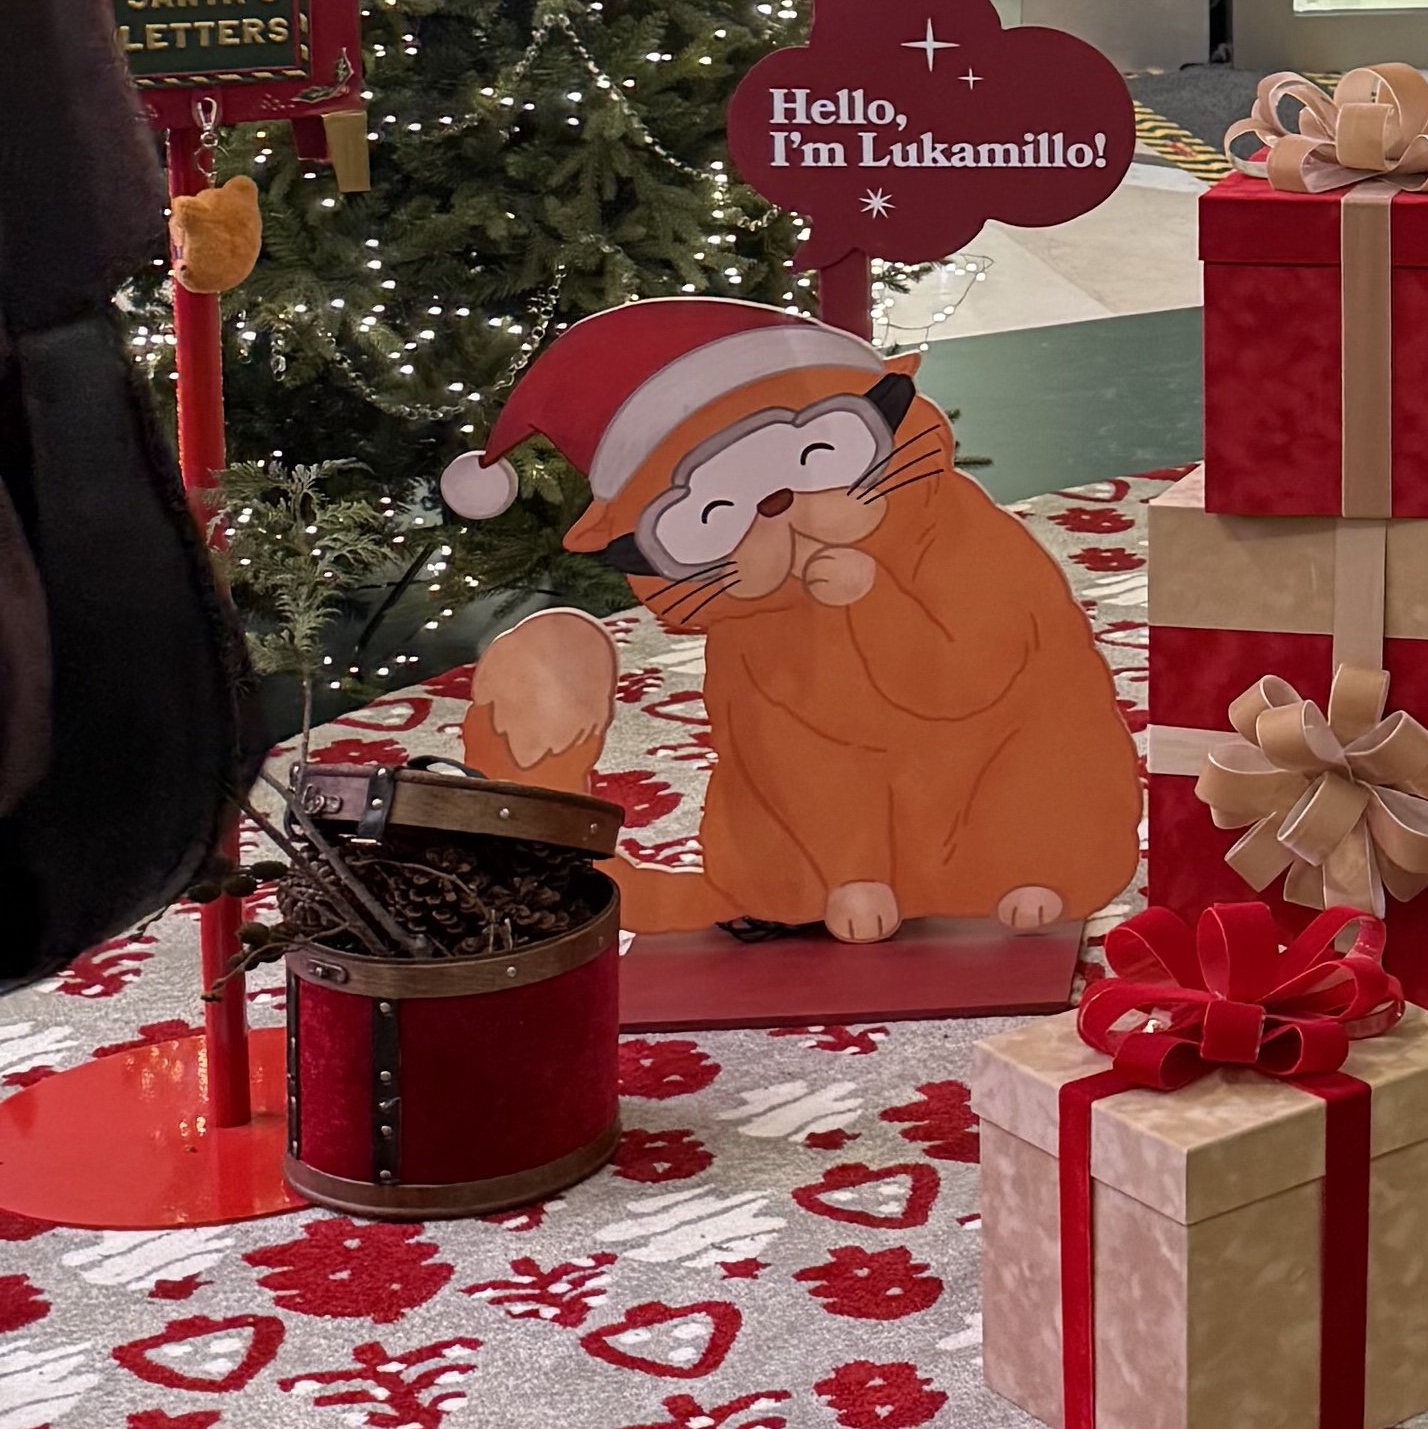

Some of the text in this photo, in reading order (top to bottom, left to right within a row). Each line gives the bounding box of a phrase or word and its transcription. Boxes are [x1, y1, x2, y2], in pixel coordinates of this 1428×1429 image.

[116, 17, 289, 53] LETTERS
[769, 87, 908, 130] Hello,
[769, 132, 1109, 169] I'm Lukamillo!
